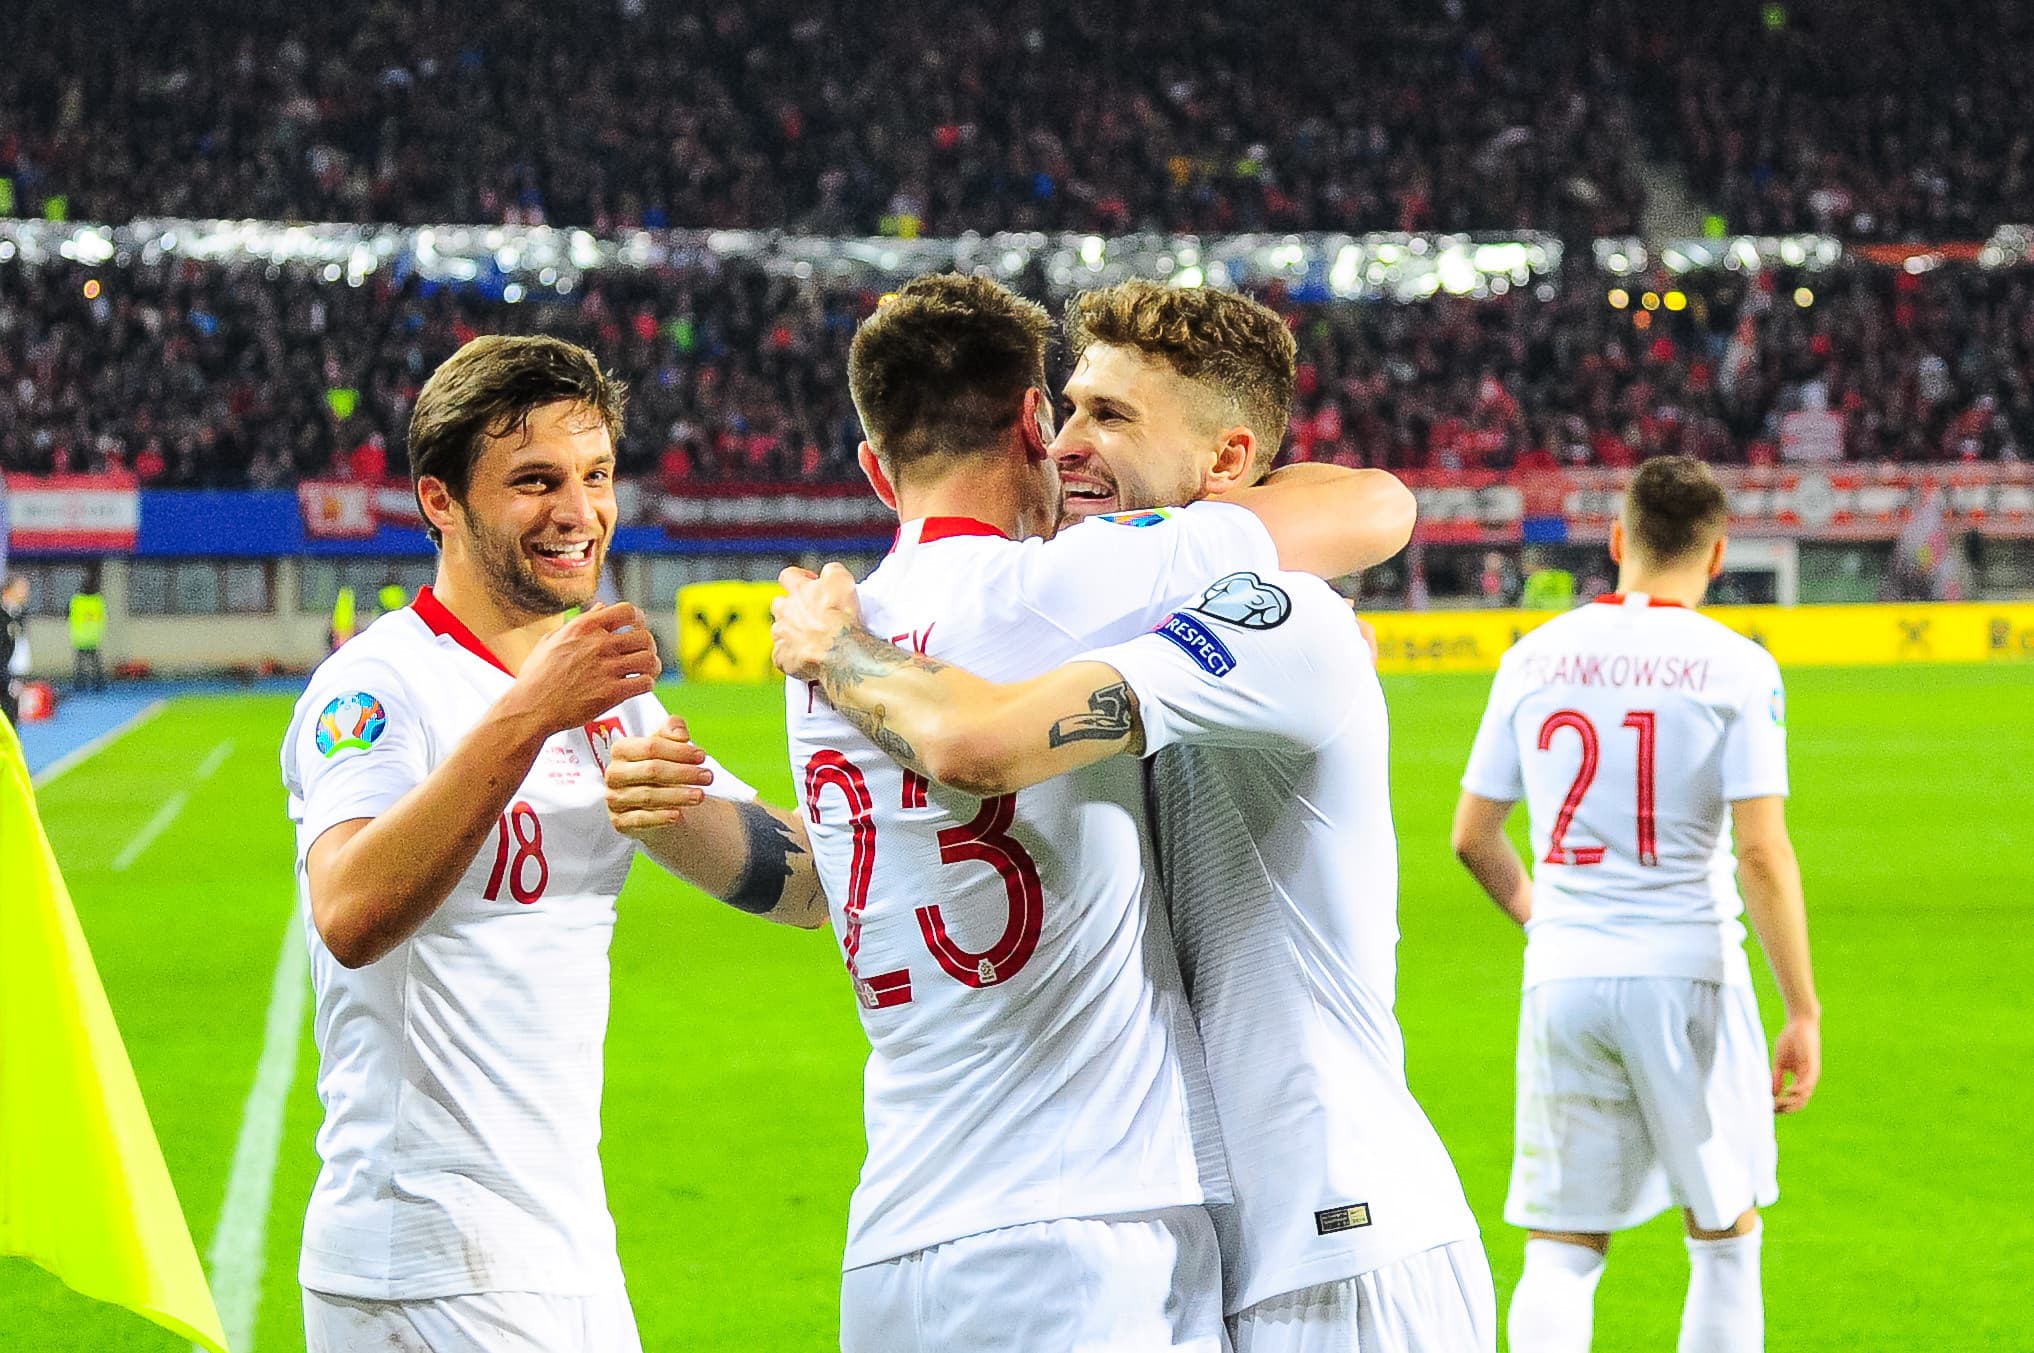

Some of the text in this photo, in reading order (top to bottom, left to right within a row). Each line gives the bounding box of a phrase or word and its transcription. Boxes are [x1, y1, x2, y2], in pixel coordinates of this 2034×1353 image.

[1164, 617, 1230, 675] RESPECT
[1537, 709, 1659, 866] 21
[483, 801, 549, 905] 18
[805, 749, 1044, 1009] 23
